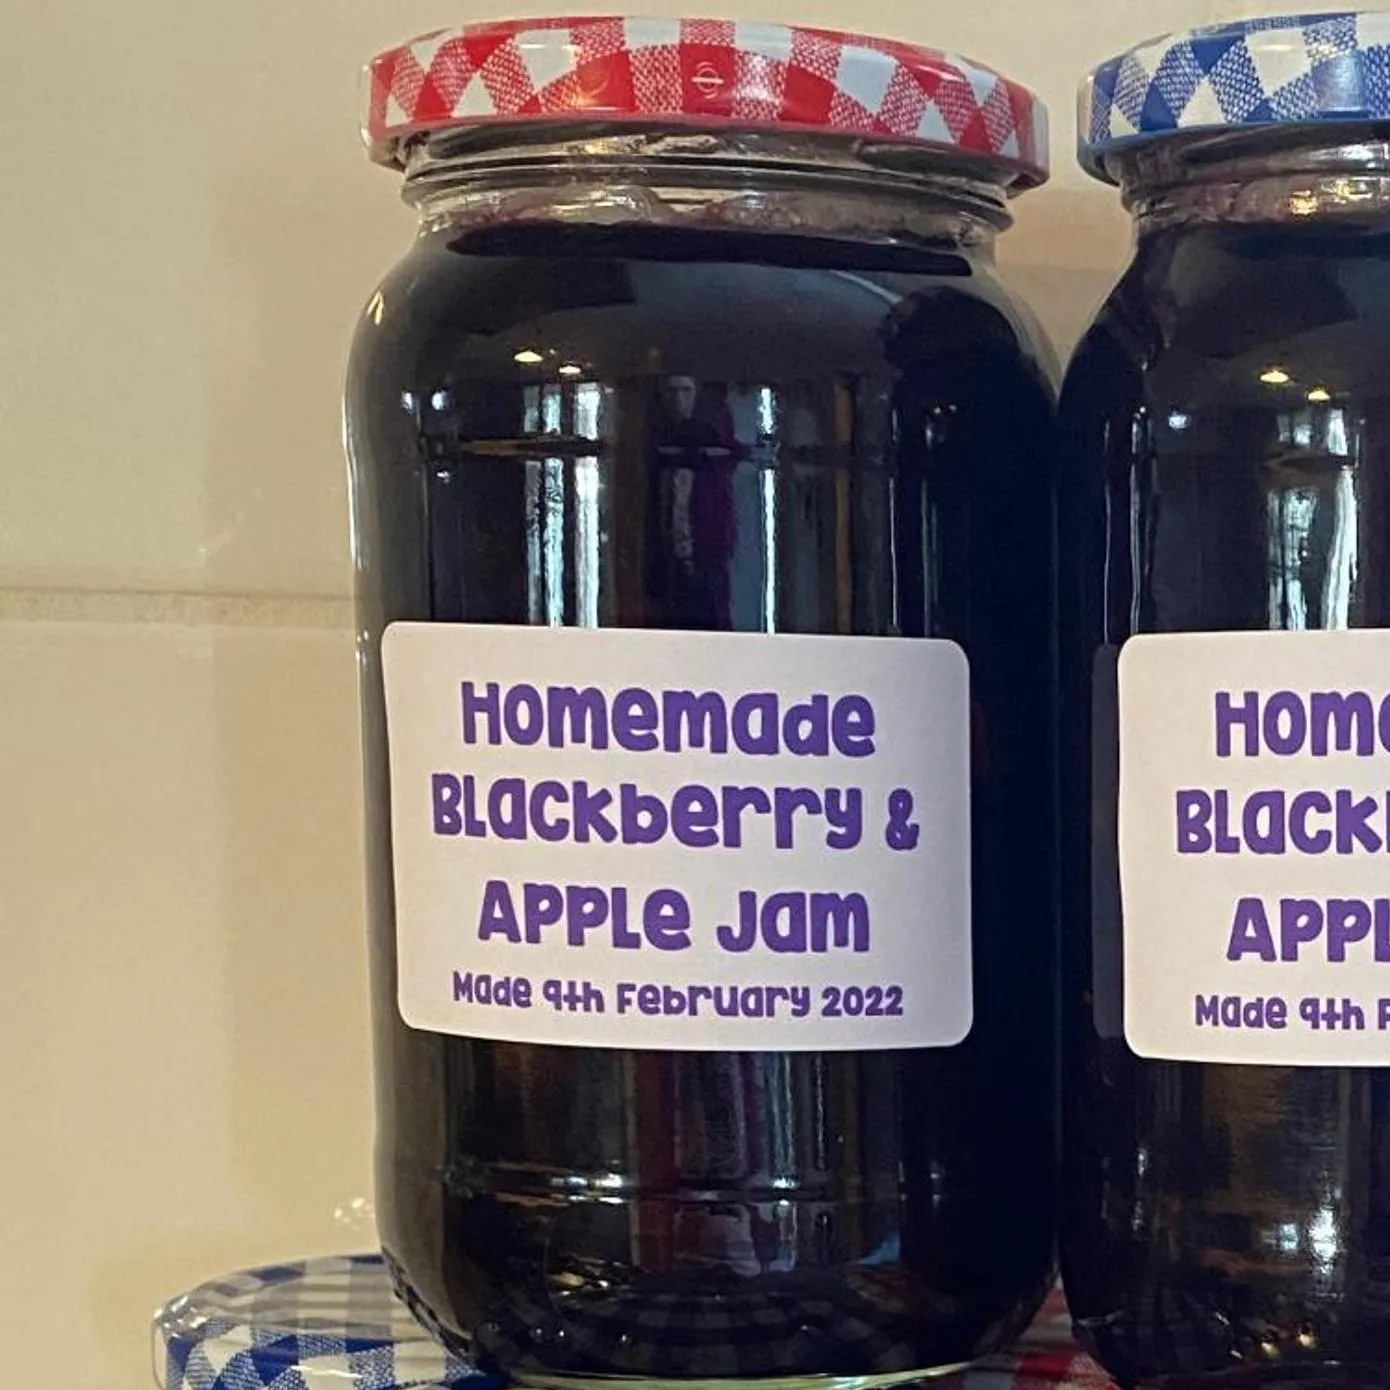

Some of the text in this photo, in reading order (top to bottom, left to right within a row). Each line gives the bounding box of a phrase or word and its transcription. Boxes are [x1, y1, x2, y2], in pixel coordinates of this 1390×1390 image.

[464, 680, 875, 757] Homemade
[885, 788, 920, 851] &
[716, 890, 870, 953] Jam
[455, 971, 903, 1017] Made 9th February 2022
[1198, 994, 1286, 1027] Made
[1300, 998, 1365, 1029] 9th
